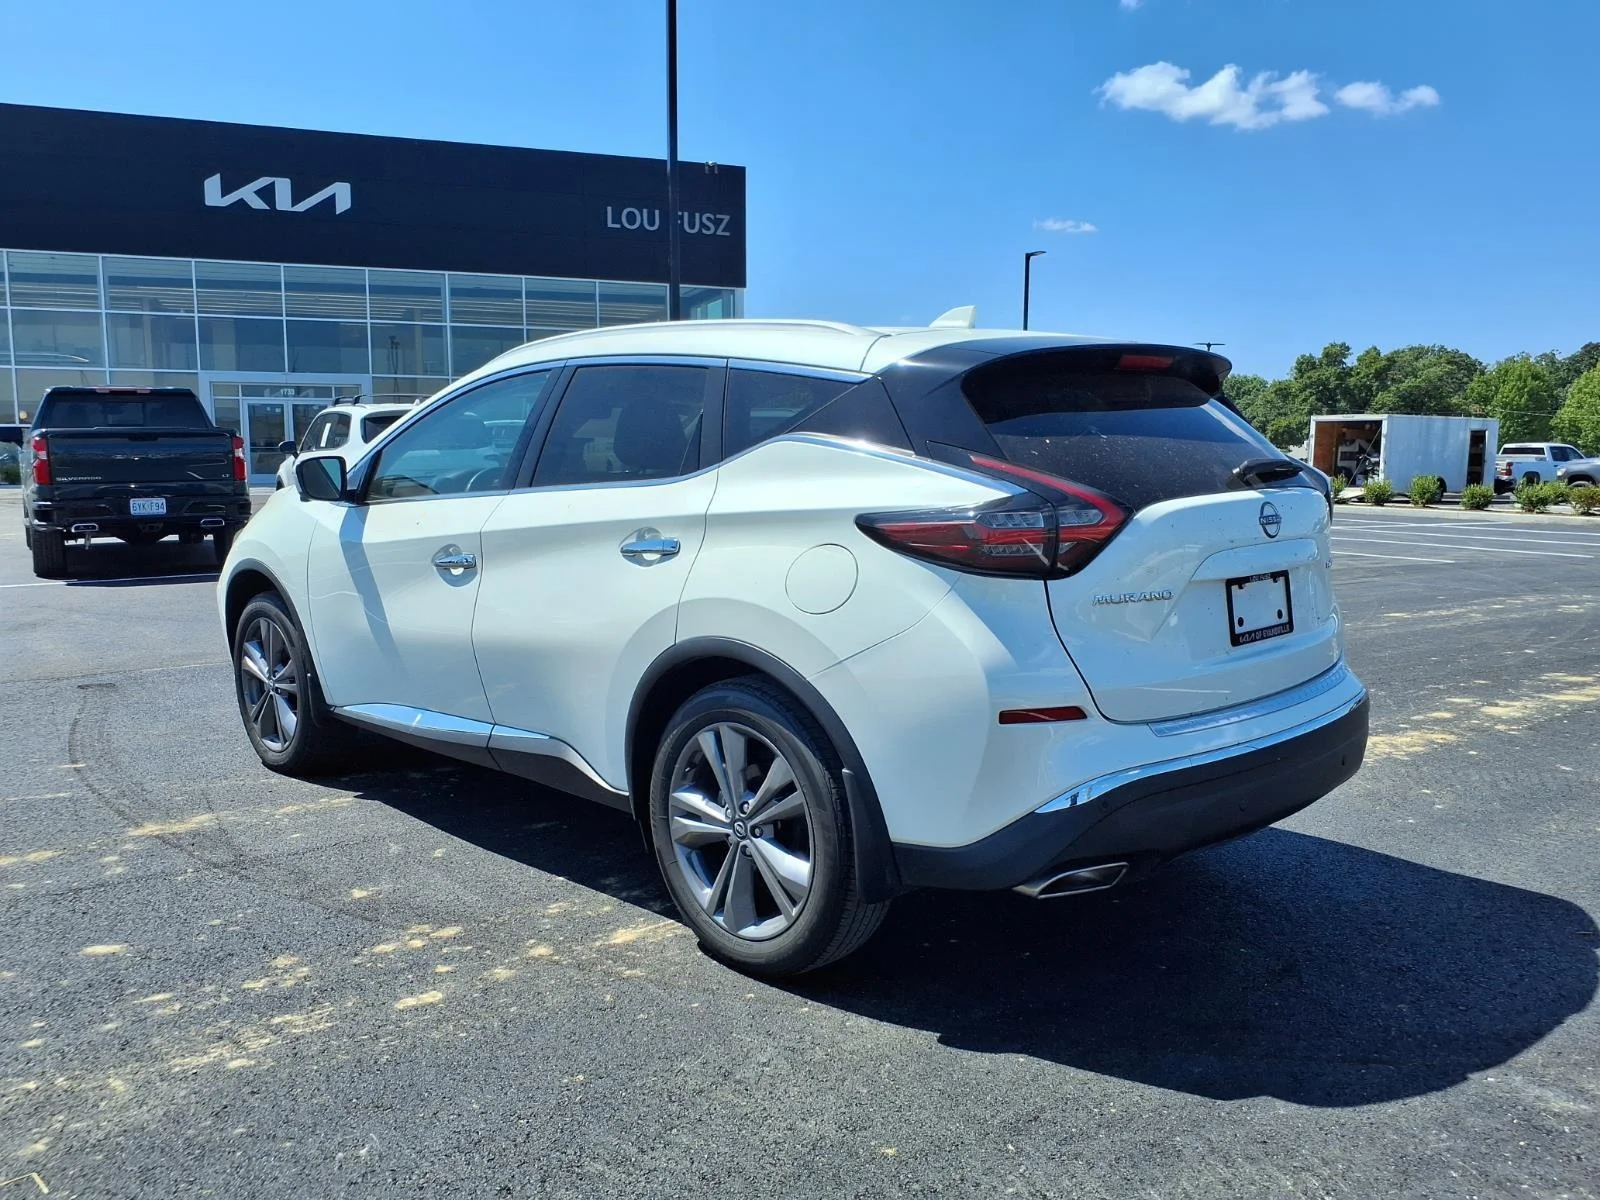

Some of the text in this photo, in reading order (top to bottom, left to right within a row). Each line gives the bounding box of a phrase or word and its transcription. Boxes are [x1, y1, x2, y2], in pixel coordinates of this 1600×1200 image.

[204, 173, 352, 215] KIA
[606, 205, 660, 231] LOU
[1092, 590, 1174, 606] MURANO
